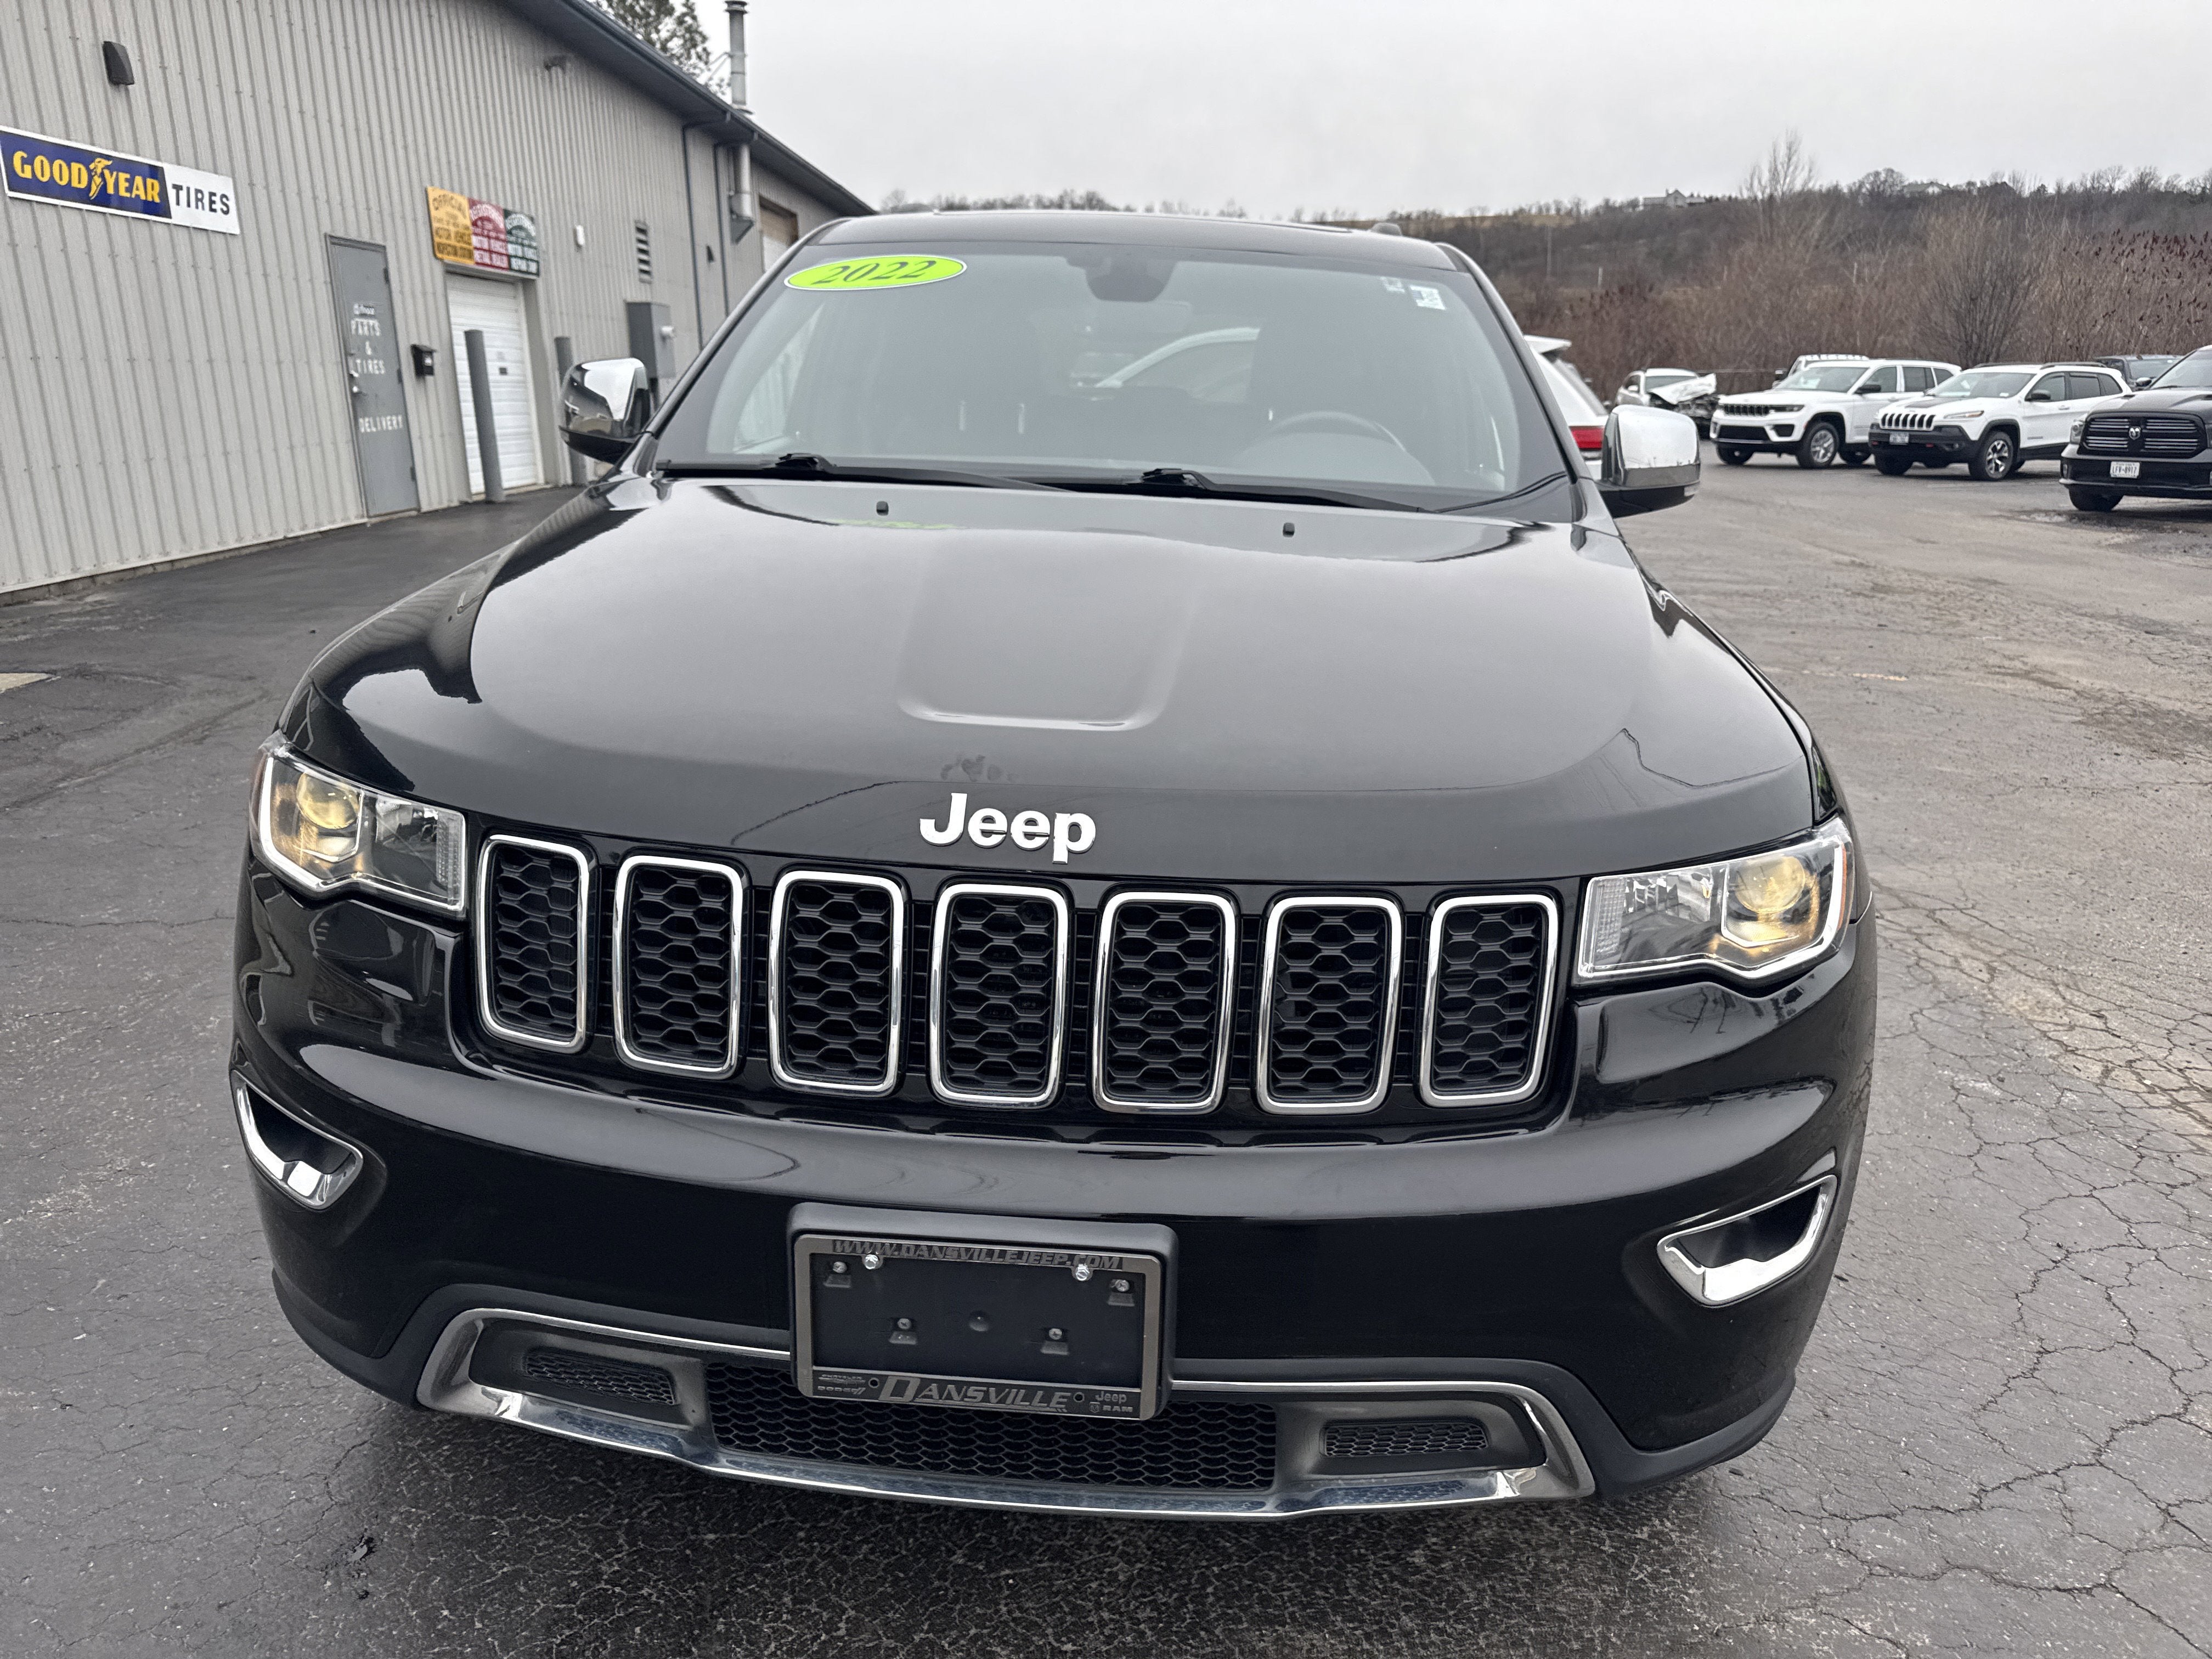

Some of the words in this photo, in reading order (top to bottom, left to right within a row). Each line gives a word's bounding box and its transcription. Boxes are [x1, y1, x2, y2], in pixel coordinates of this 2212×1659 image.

[172, 184, 230, 215] TIRES
[810, 259, 936, 285] 2022
[356, 359, 385, 374] TIRES
[919, 792, 1096, 864] Jeep
[878, 1375, 1071, 1408] DANSVILLE
[1095, 1391, 1127, 1403] Jeep
